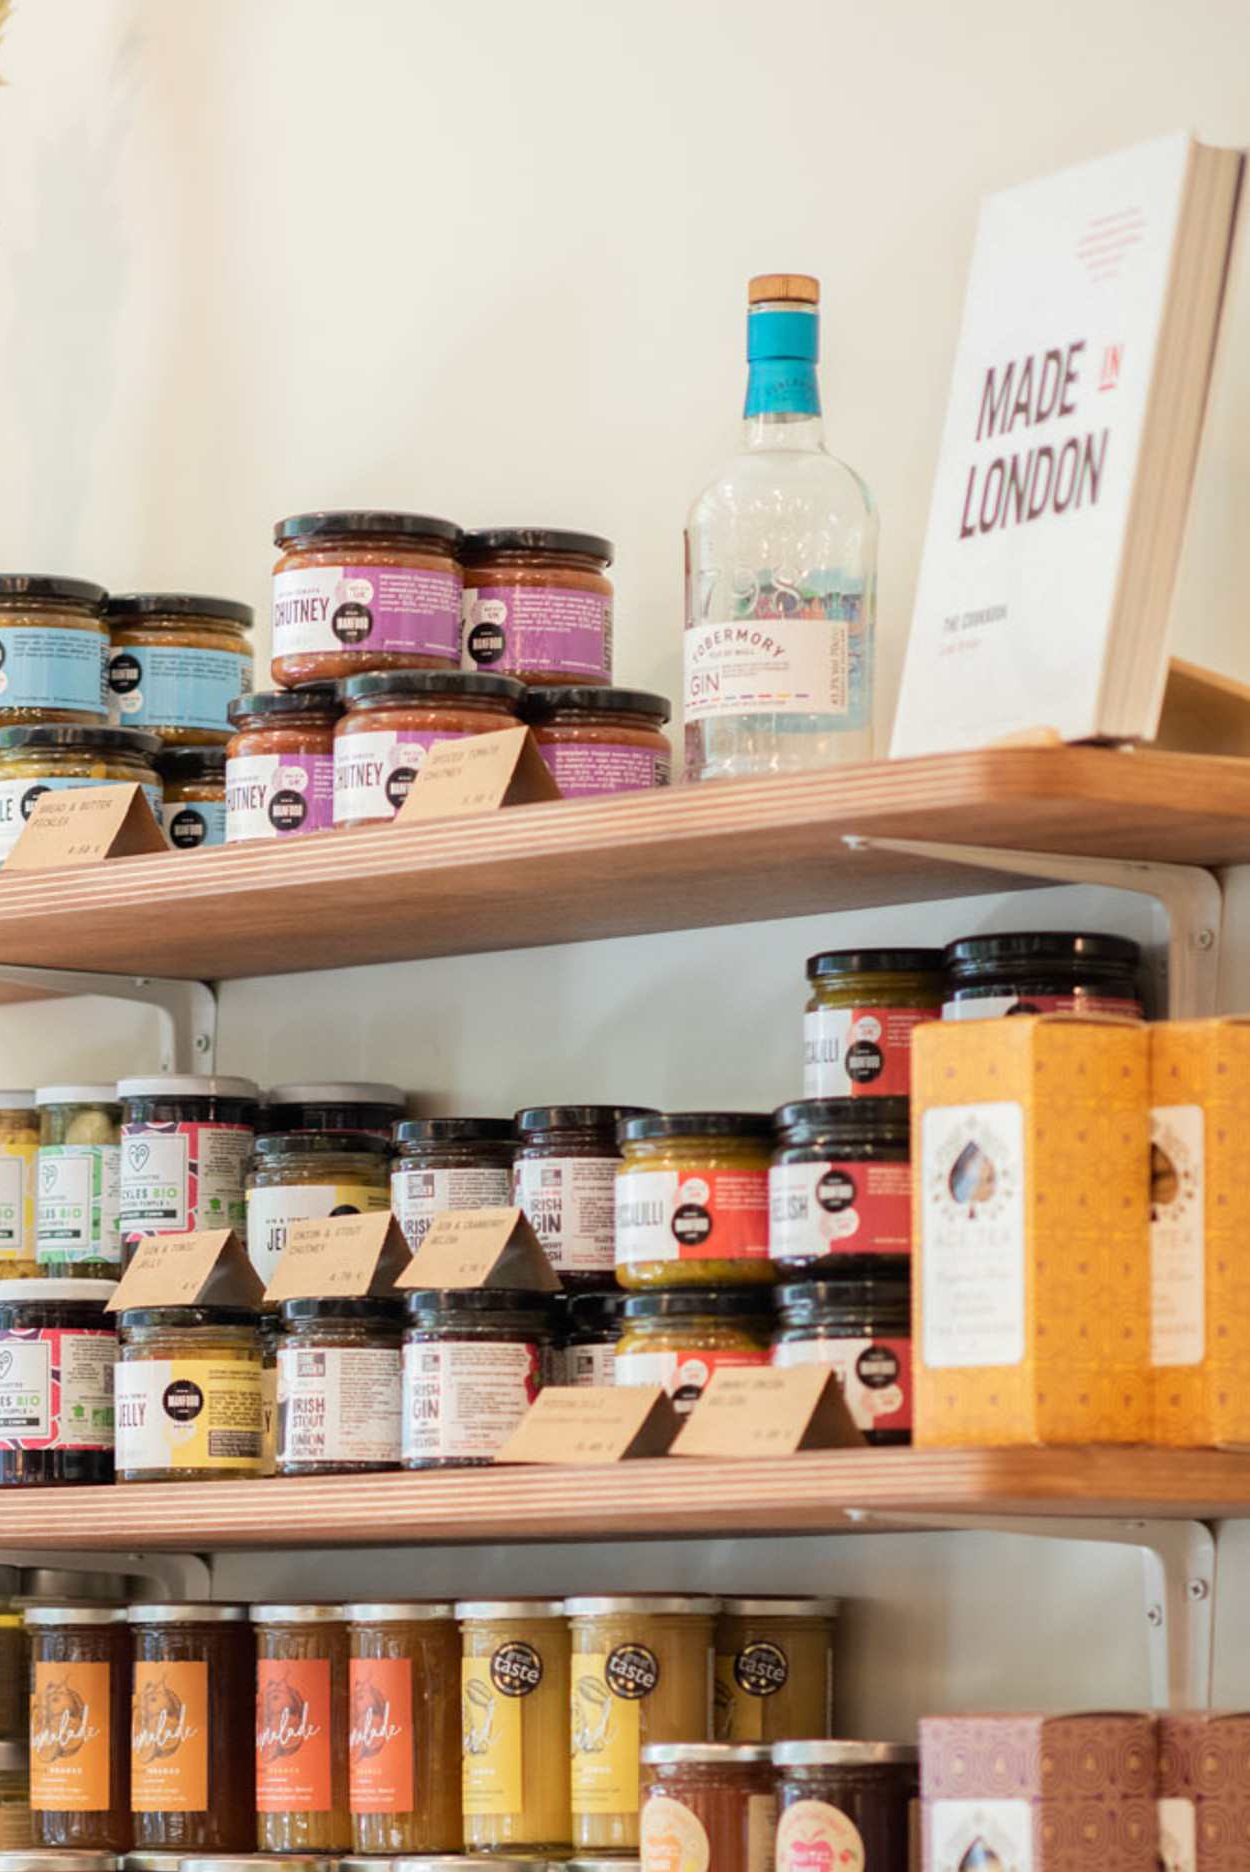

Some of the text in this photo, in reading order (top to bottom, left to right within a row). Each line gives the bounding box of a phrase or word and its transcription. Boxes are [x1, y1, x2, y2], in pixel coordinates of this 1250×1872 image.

[975, 339, 1124, 442] MADE IN
[959, 429, 1109, 540] LONDON
[275, 597, 329, 627] CHUTNEY
[692, 629, 785, 662] TOBERMORY
[690, 674, 720, 696] GIN
[228, 785, 267, 812] HUTNEY
[152, 1187, 178, 1199] BIO
[530, 1198, 562, 1213] IRISH
[771, 1196, 809, 1223] ELISH
[531, 1213, 562, 1234] GIN
[17, 1395, 41, 1407] BIO
[293, 1397, 325, 1413] IRISH
[413, 1399, 439, 1420] GIN
[293, 1414, 325, 1428] STOUT
[494, 1658, 539, 1684] taste
[609, 1662, 655, 1687] taste
[738, 1660, 786, 1682] taste
